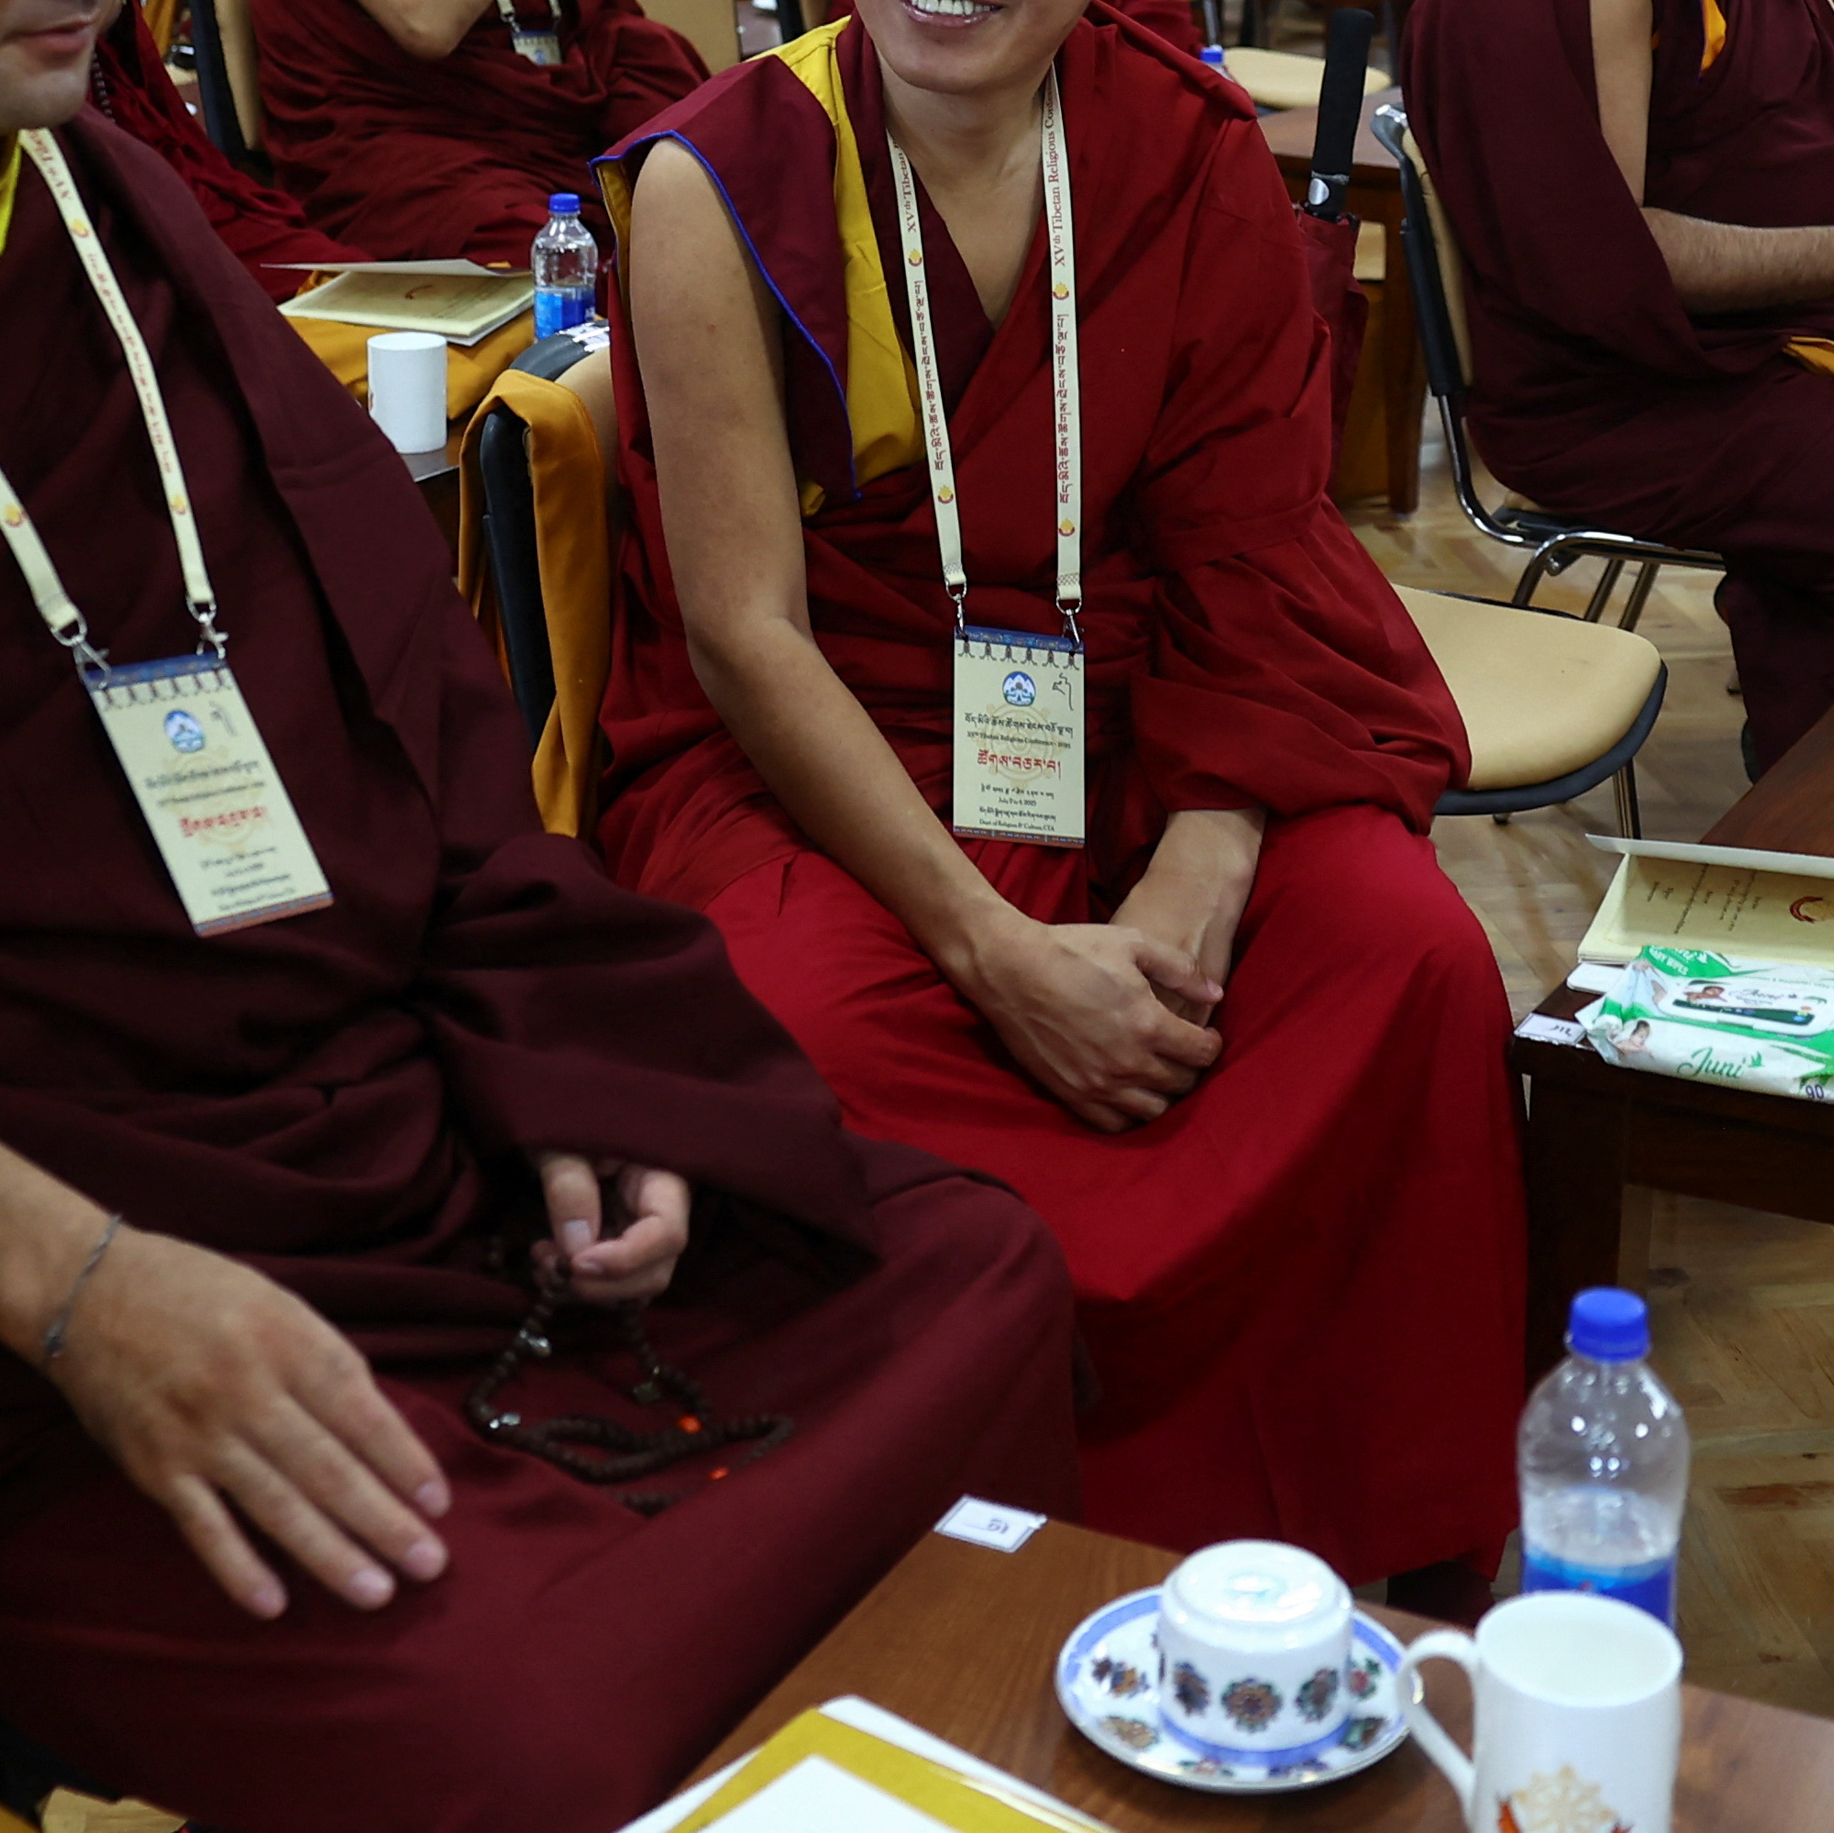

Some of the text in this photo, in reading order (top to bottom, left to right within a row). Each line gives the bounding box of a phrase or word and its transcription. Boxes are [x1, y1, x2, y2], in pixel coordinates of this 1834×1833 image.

[897, 152, 913, 200] Tibetan
[1044, 131, 1060, 184] Religious
[1051, 186, 1063, 234] Tibetan
[1666, 956, 1689, 976] WIPES
[1678, 1046, 1748, 1080] Juni
[1804, 1083, 1826, 1101] 90
